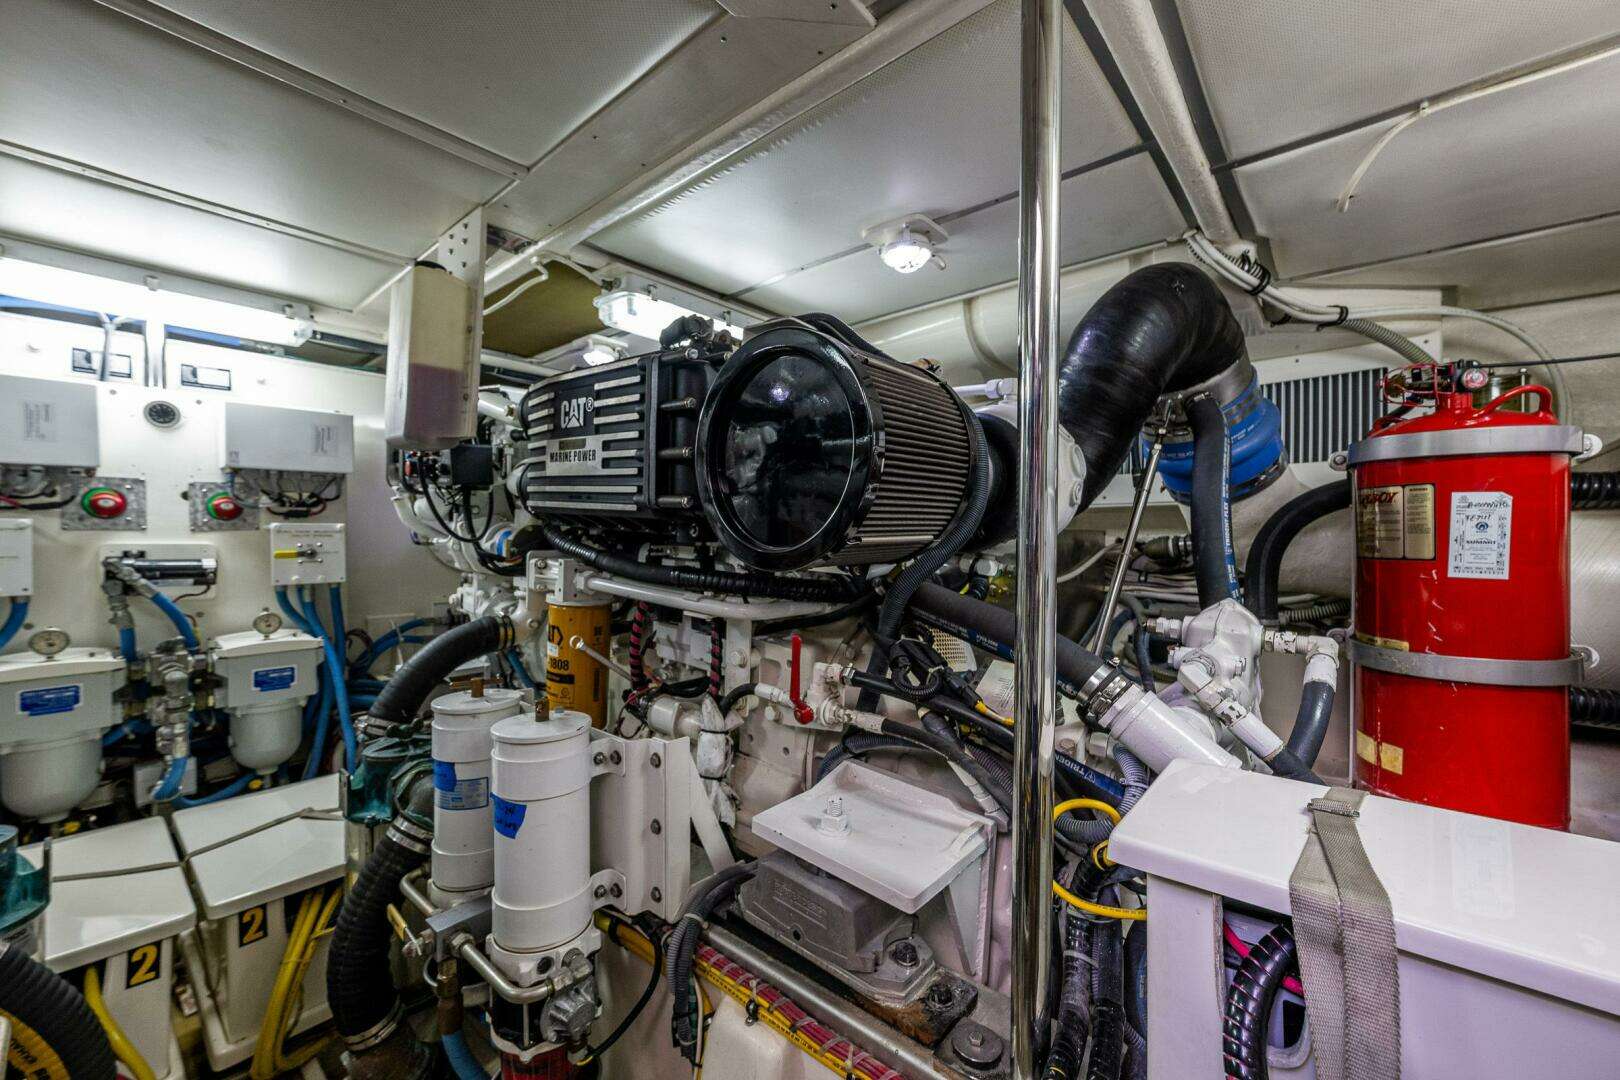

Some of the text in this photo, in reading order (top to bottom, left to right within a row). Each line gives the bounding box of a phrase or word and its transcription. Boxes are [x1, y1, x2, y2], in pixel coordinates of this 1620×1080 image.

[550, 449, 596, 463] MARINE POWER
[242, 907, 264, 944] 2
[129, 945, 158, 986] 2
